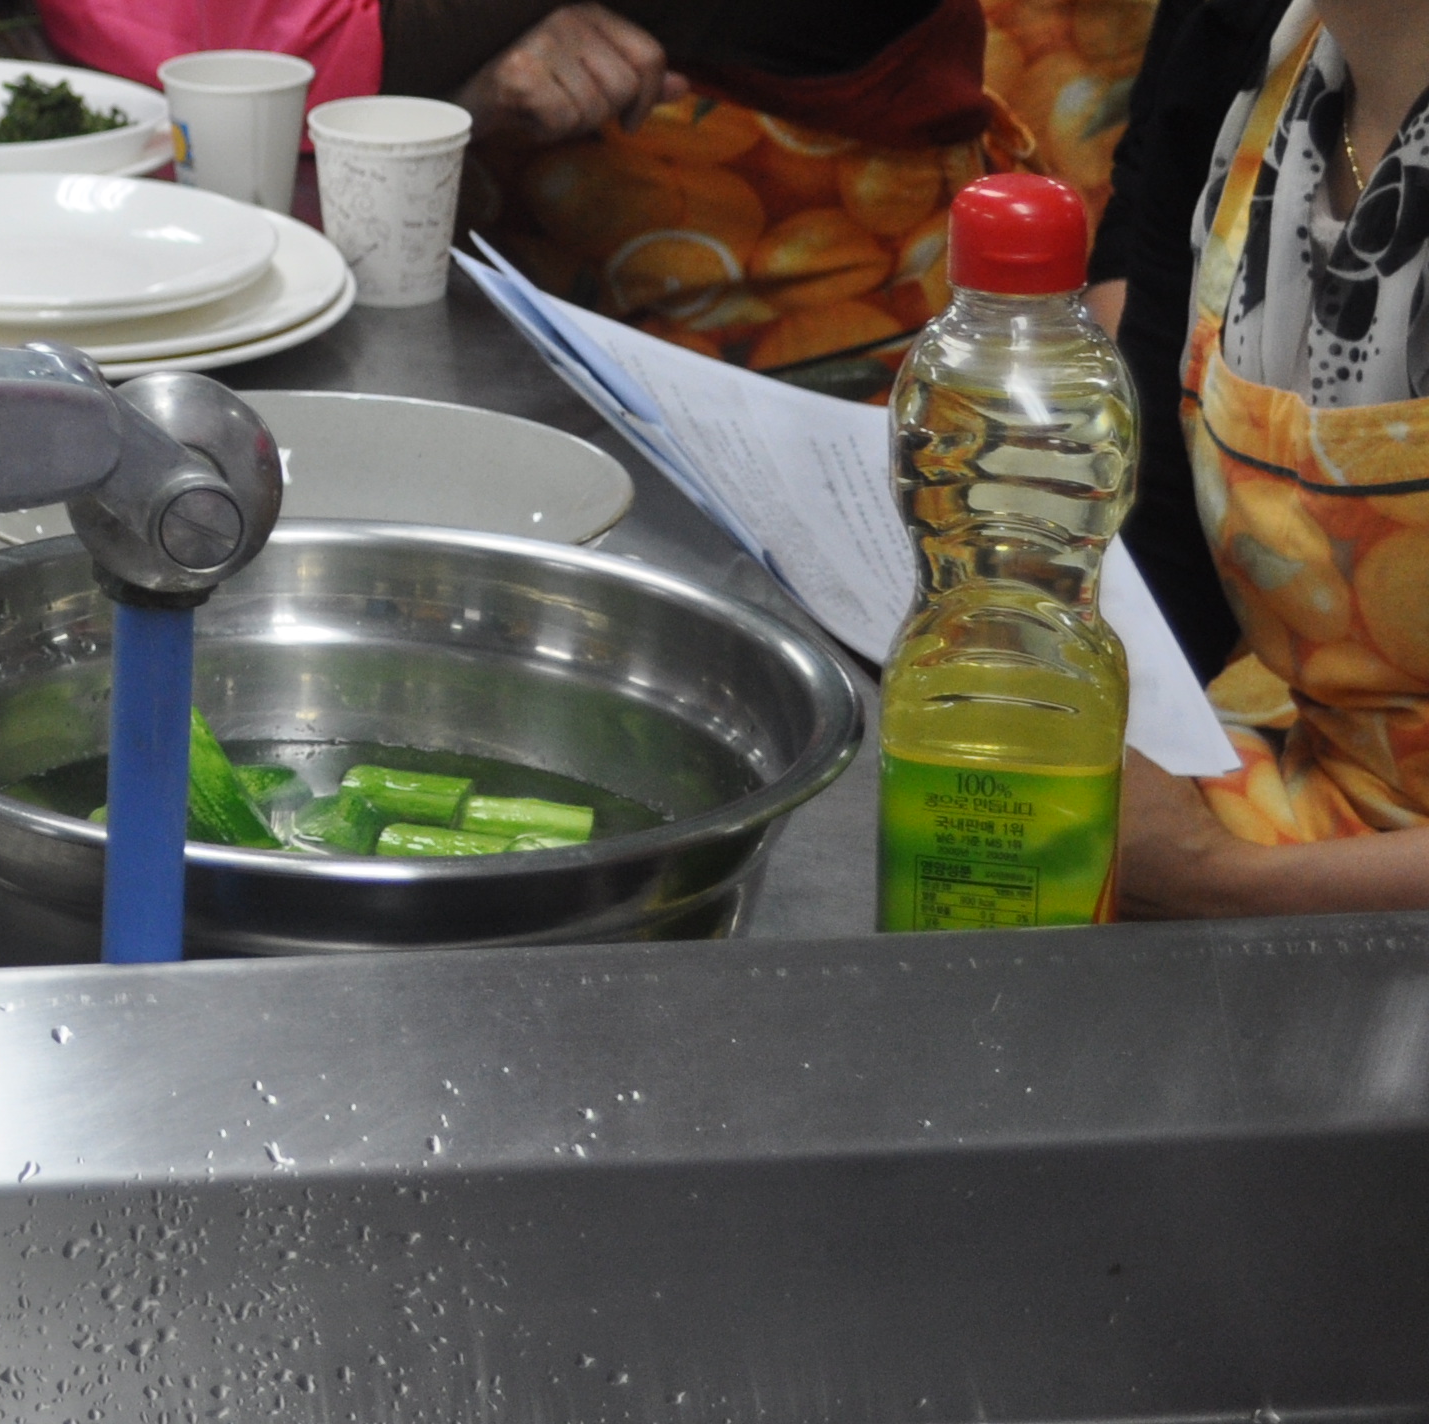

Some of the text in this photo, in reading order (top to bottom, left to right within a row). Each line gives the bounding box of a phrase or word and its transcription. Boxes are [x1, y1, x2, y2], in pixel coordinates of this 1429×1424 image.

[955, 772, 1013, 799] 100%
[934, 815, 1024, 837] 국내판매 1위
[920, 860, 972, 878] 영양성분
